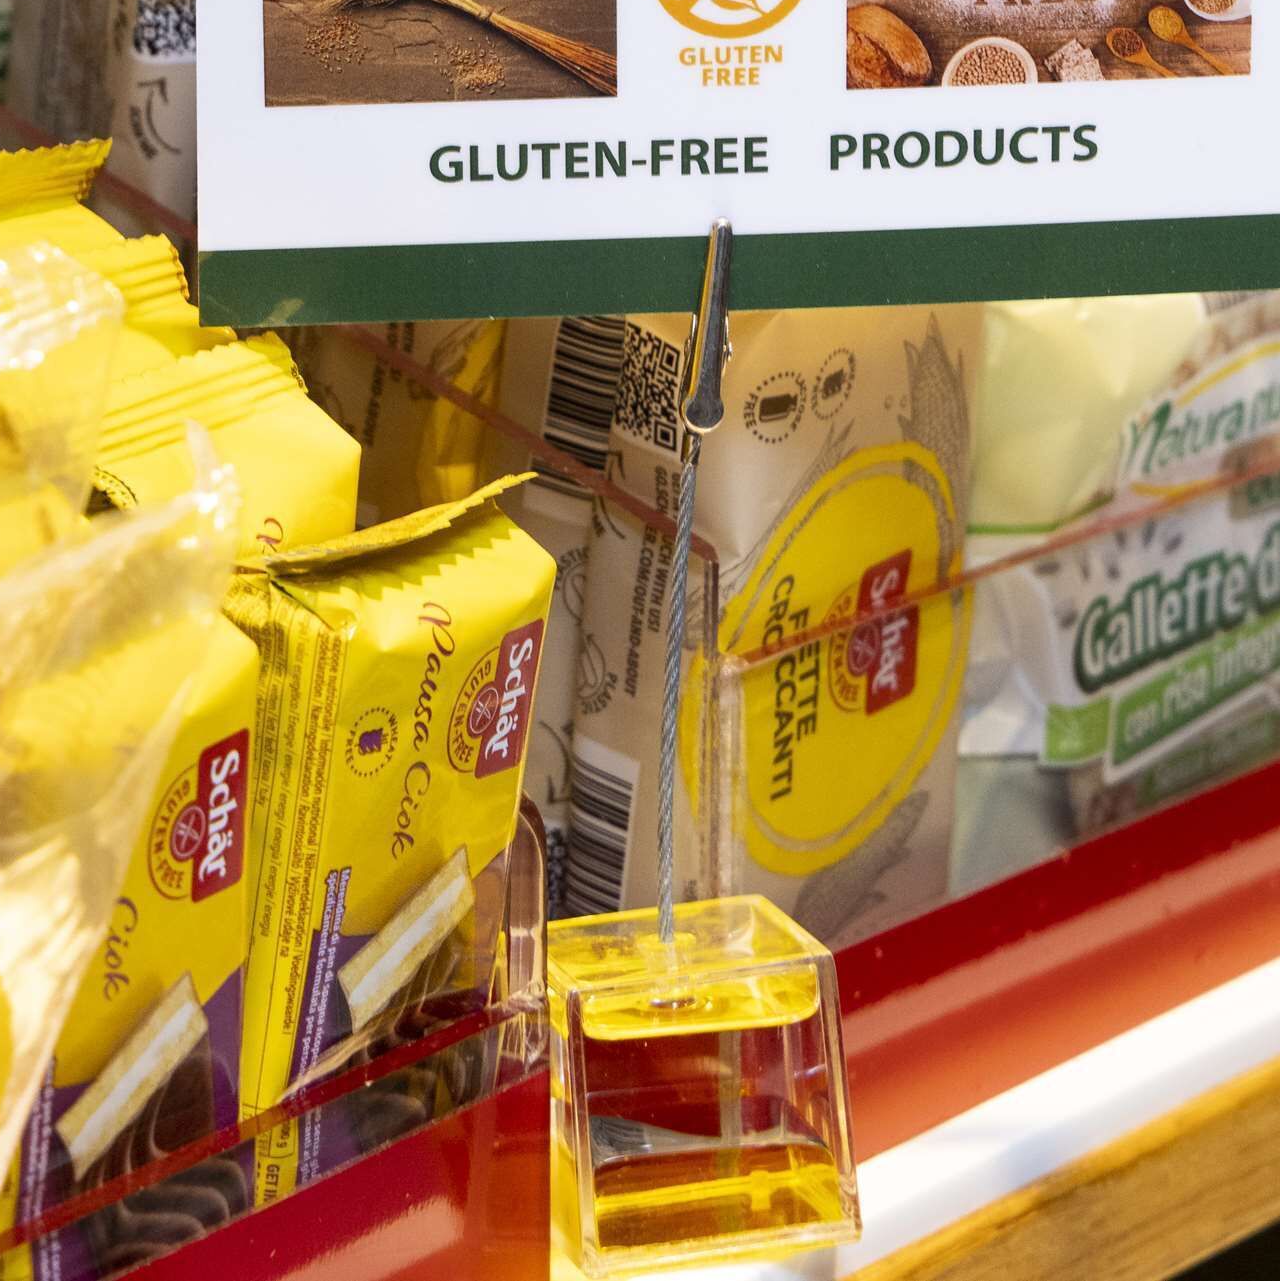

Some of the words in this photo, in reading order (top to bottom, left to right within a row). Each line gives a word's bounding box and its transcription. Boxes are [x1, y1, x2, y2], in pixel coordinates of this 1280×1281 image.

[678, 44, 783, 66] GLUTEN
[701, 66, 760, 87] FREE
[429, 136, 769, 183] GLUTEN-FREE
[830, 124, 1098, 171] PRODUCTS
[743, 392, 759, 429] FREE
[624, 466, 668, 698] GO.SCHER.COM/OUT-AND-ABOUT
[651, 568, 669, 606] WITH
[1077, 552, 1247, 686] Gallette
[414, 603, 456, 752] Pausa
[485, 637, 533, 761] Schär
[387, 713, 399, 762] WHEAT
[452, 658, 492, 763] GLUTEN-FREE
[345, 730, 356, 764] FREE
[153, 779, 191, 889] GLUTEN-FREE
[199, 749, 240, 882] Schär
[391, 761, 431, 860] Ciok
[318, 871, 338, 956] specificamente
[333, 868, 351, 932] Merendina
[103, 896, 138, 1001] Ciok
[326, 947, 337, 968] pan
[308, 959, 327, 1014] formulata
[266, 1165, 280, 1186] GET
